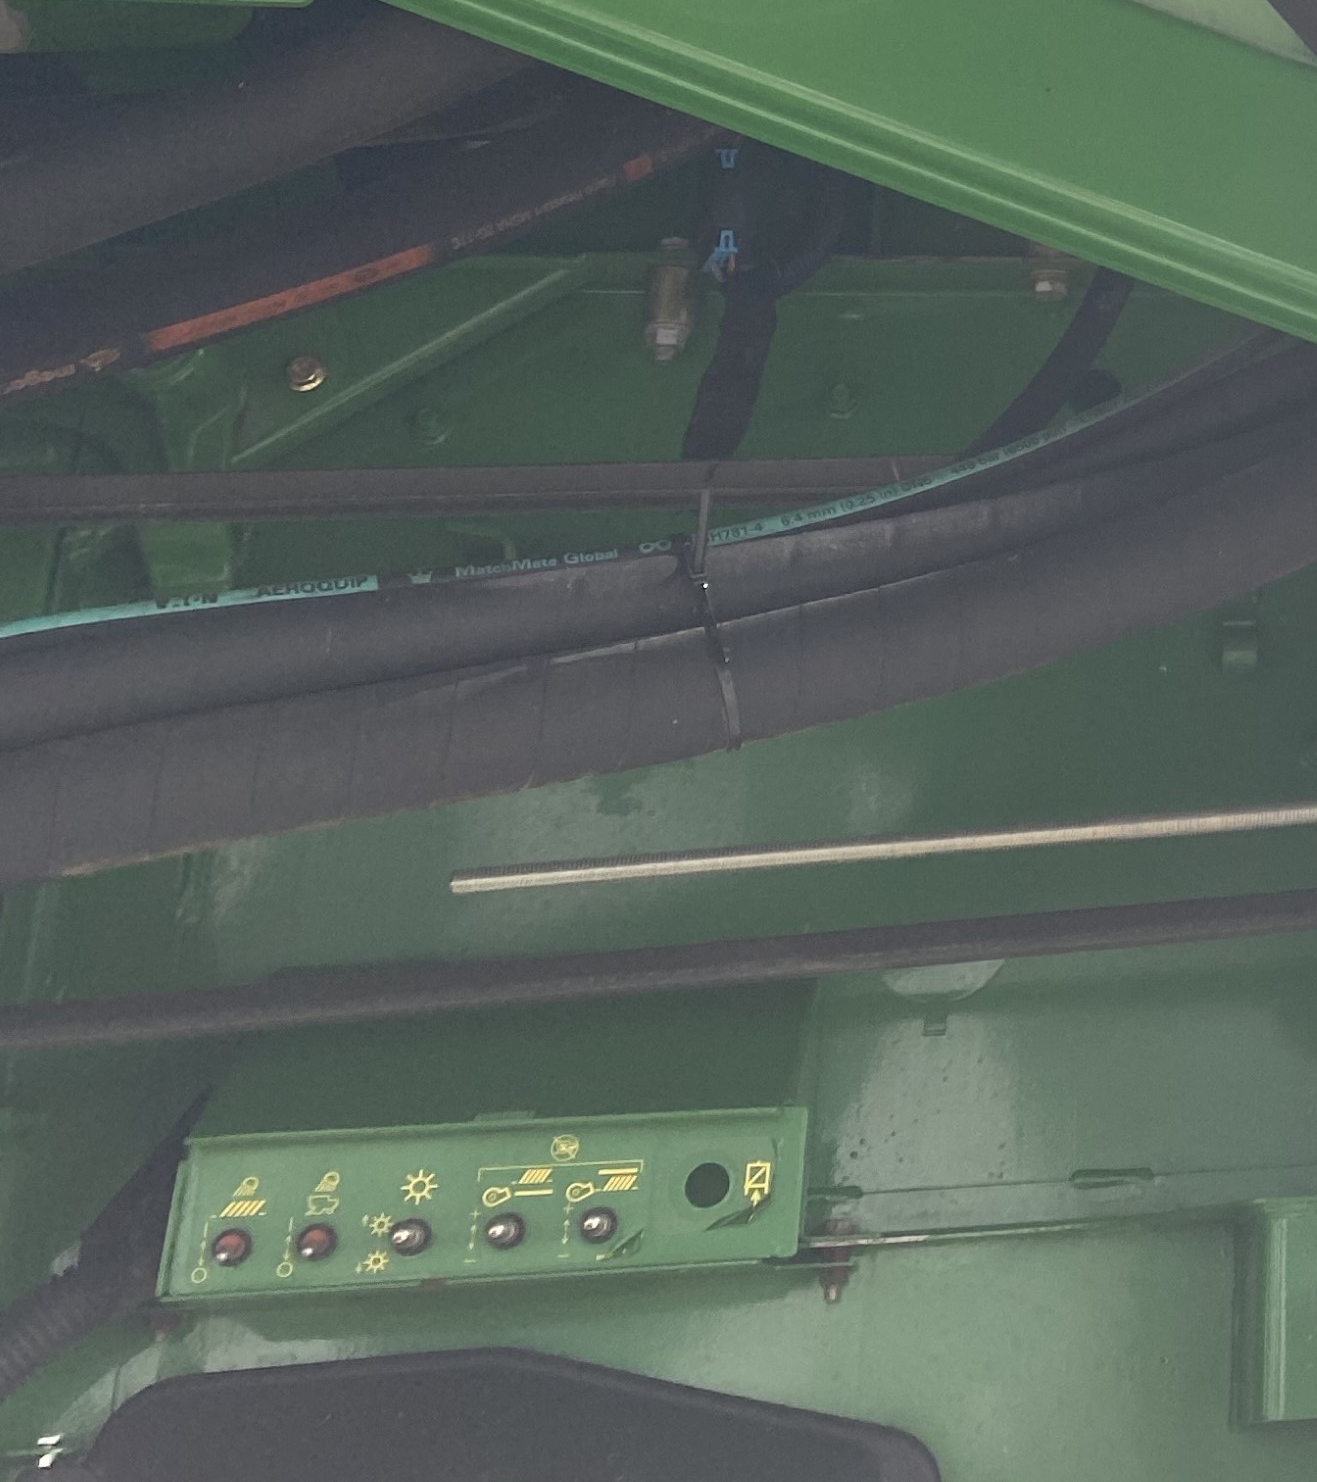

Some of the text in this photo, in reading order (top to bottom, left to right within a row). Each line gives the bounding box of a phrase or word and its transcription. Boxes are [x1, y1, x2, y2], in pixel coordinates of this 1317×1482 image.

[706, 522, 764, 542] H781-4
[807, 504, 836, 519] mm
[454, 547, 618, 578] MatchMate Global
[258, 577, 368, 599] AEROQUIP
